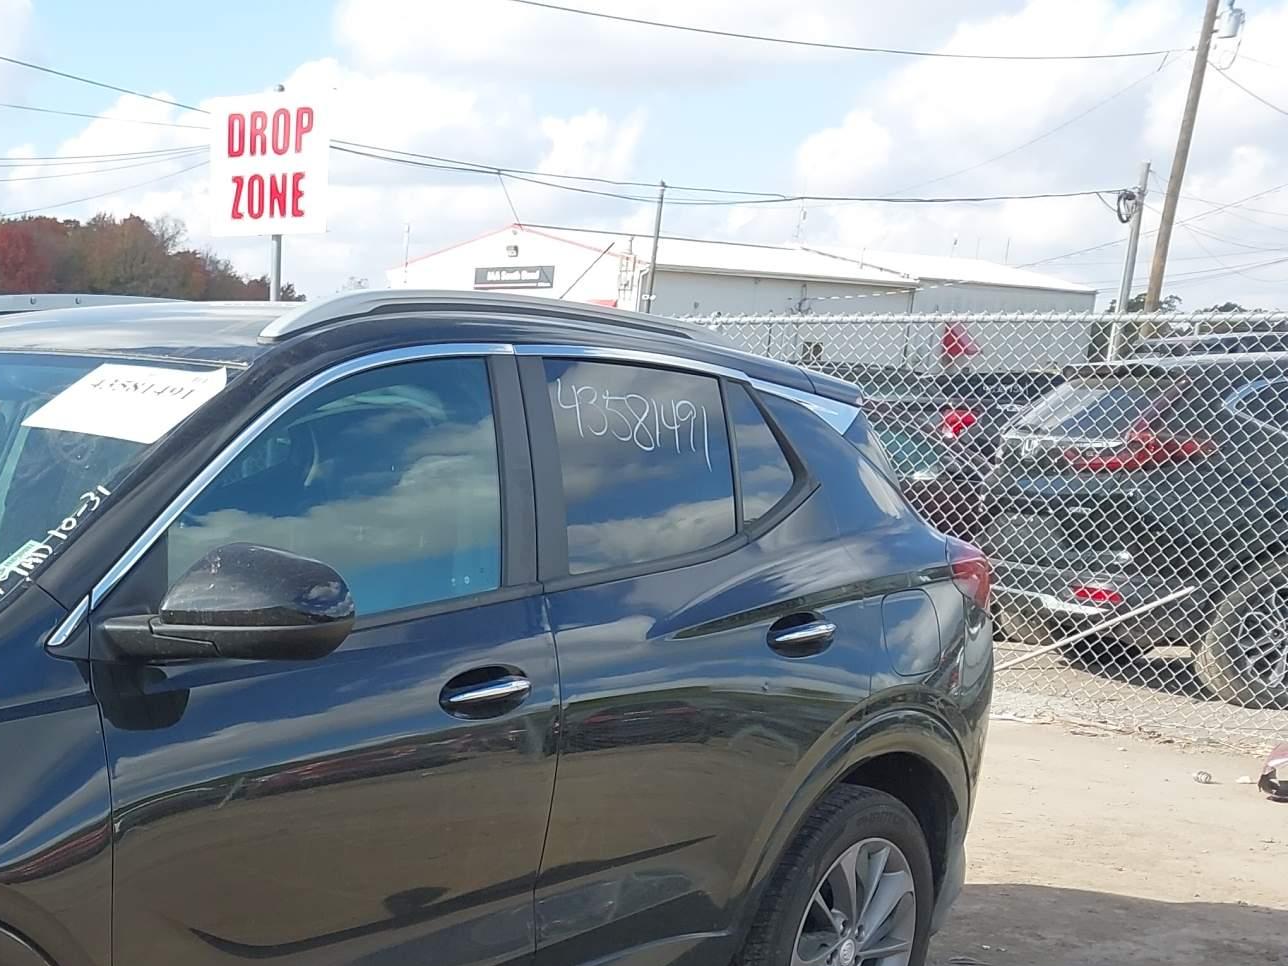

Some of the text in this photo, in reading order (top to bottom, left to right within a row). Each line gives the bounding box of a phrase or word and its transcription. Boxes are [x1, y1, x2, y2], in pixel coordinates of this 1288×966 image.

[227, 106, 314, 158] DROP
[231, 172, 306, 220] ZONE
[555, 377, 713, 473] 43581491
[47, 484, 112, 540] 10-31
